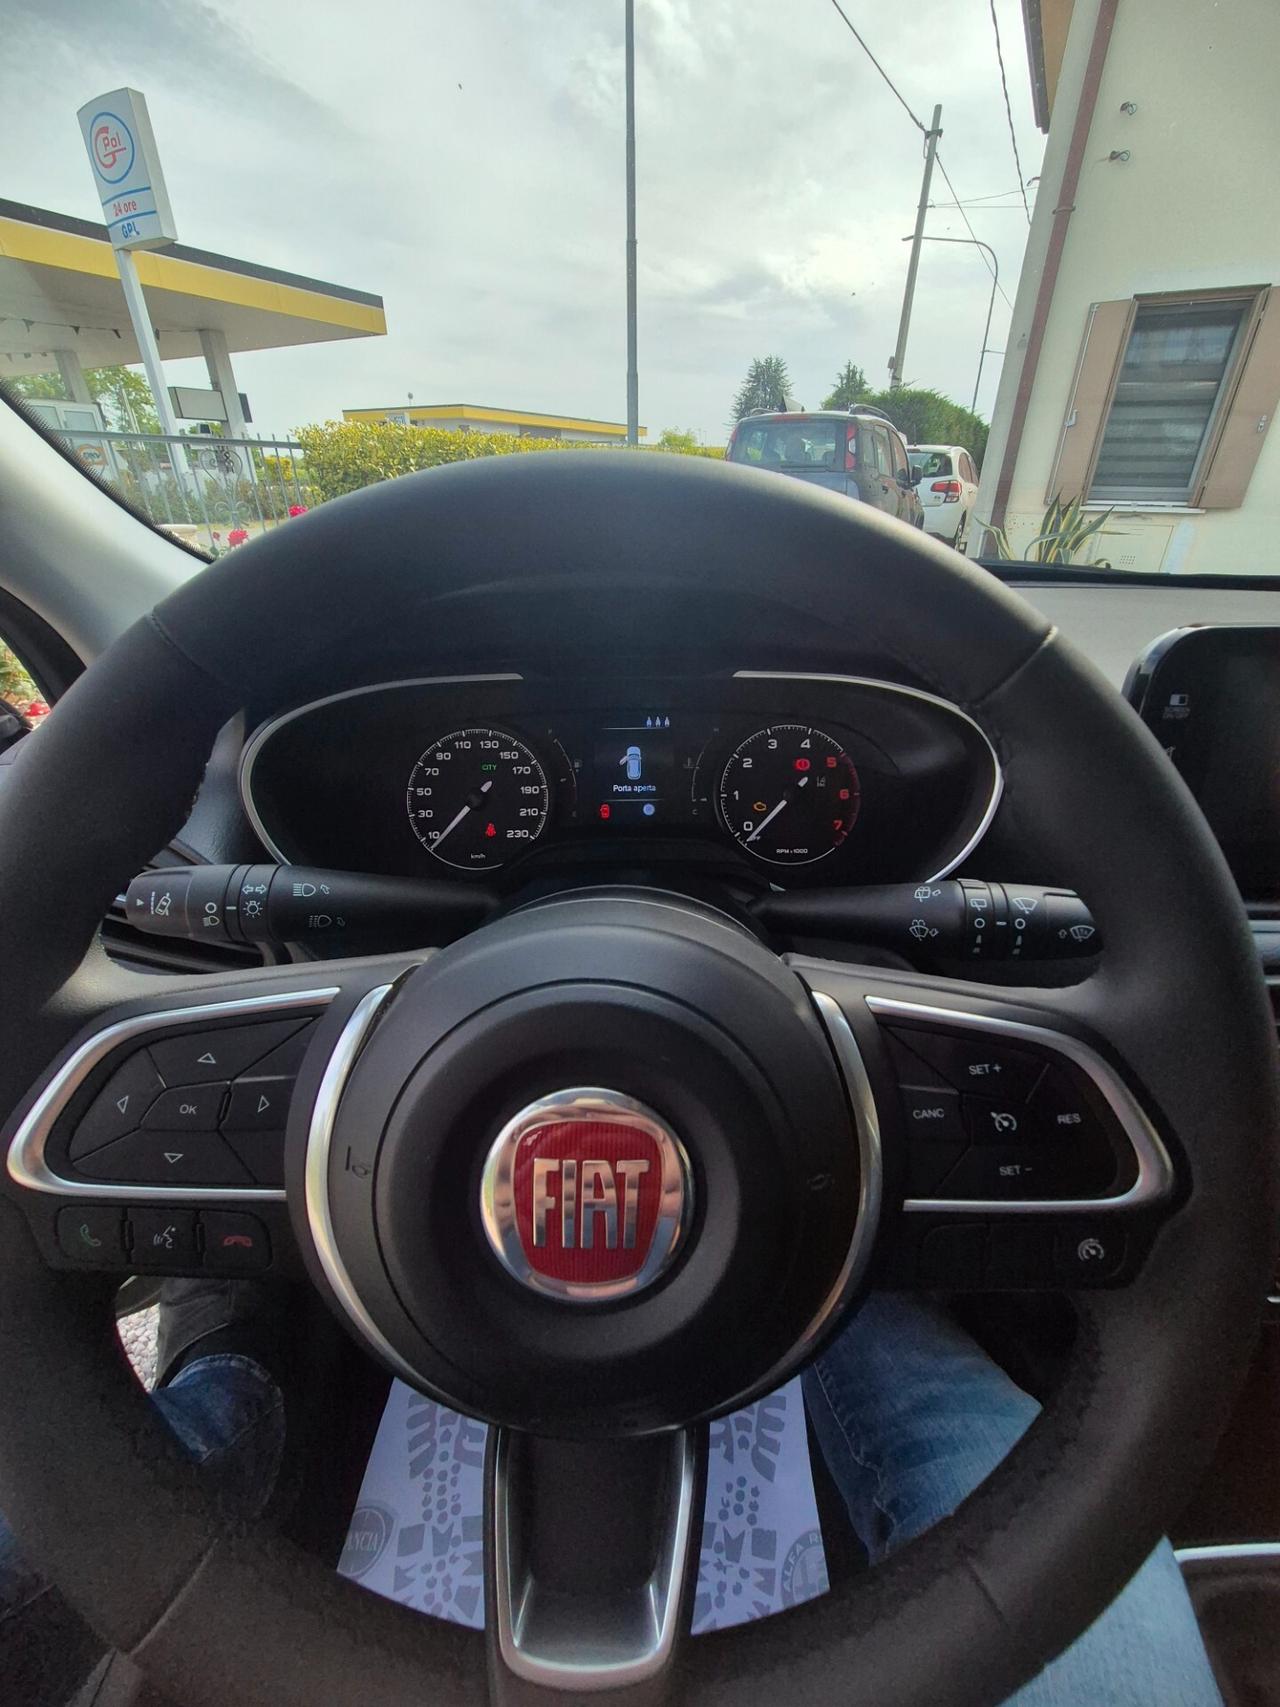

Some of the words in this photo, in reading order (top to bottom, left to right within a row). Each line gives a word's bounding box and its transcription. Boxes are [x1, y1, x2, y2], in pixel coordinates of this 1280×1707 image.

[112, 203, 122, 217] 24
[123, 200, 137, 212] ore
[121, 222, 140, 239] GPL
[454, 741, 472, 749] 110
[480, 741, 499, 749] 130
[767, 739, 778, 749] 3
[800, 739, 811, 749] 4
[436, 753, 451, 761] 90
[500, 751, 519, 760] 150
[742, 758, 753, 768] 2
[826, 757, 837, 768] 5
[424, 767, 439, 776] 70
[513, 766, 531, 775] 170
[416, 787, 432, 796] 50
[520, 785, 540, 794] 190
[612, 784, 632, 792] Porta
[633, 785, 656, 793] aperta
[733, 790, 740, 800] 1
[839, 789, 849, 800] 6
[418, 809, 433, 818] 30
[519, 808, 539, 817] 210
[743, 821, 753, 832] 0
[834, 820, 843, 830] 7
[428, 830, 440, 840] 10
[506, 830, 529, 839] 230
[969, 1064, 990, 1075] SET
[179, 1104, 197, 1115] OK
[913, 1108, 945, 1120] CANC
[1057, 1113, 1081, 1125] RES
[999, 1165, 1021, 1176] SET
[533, 1157, 650, 1249] FIAT
